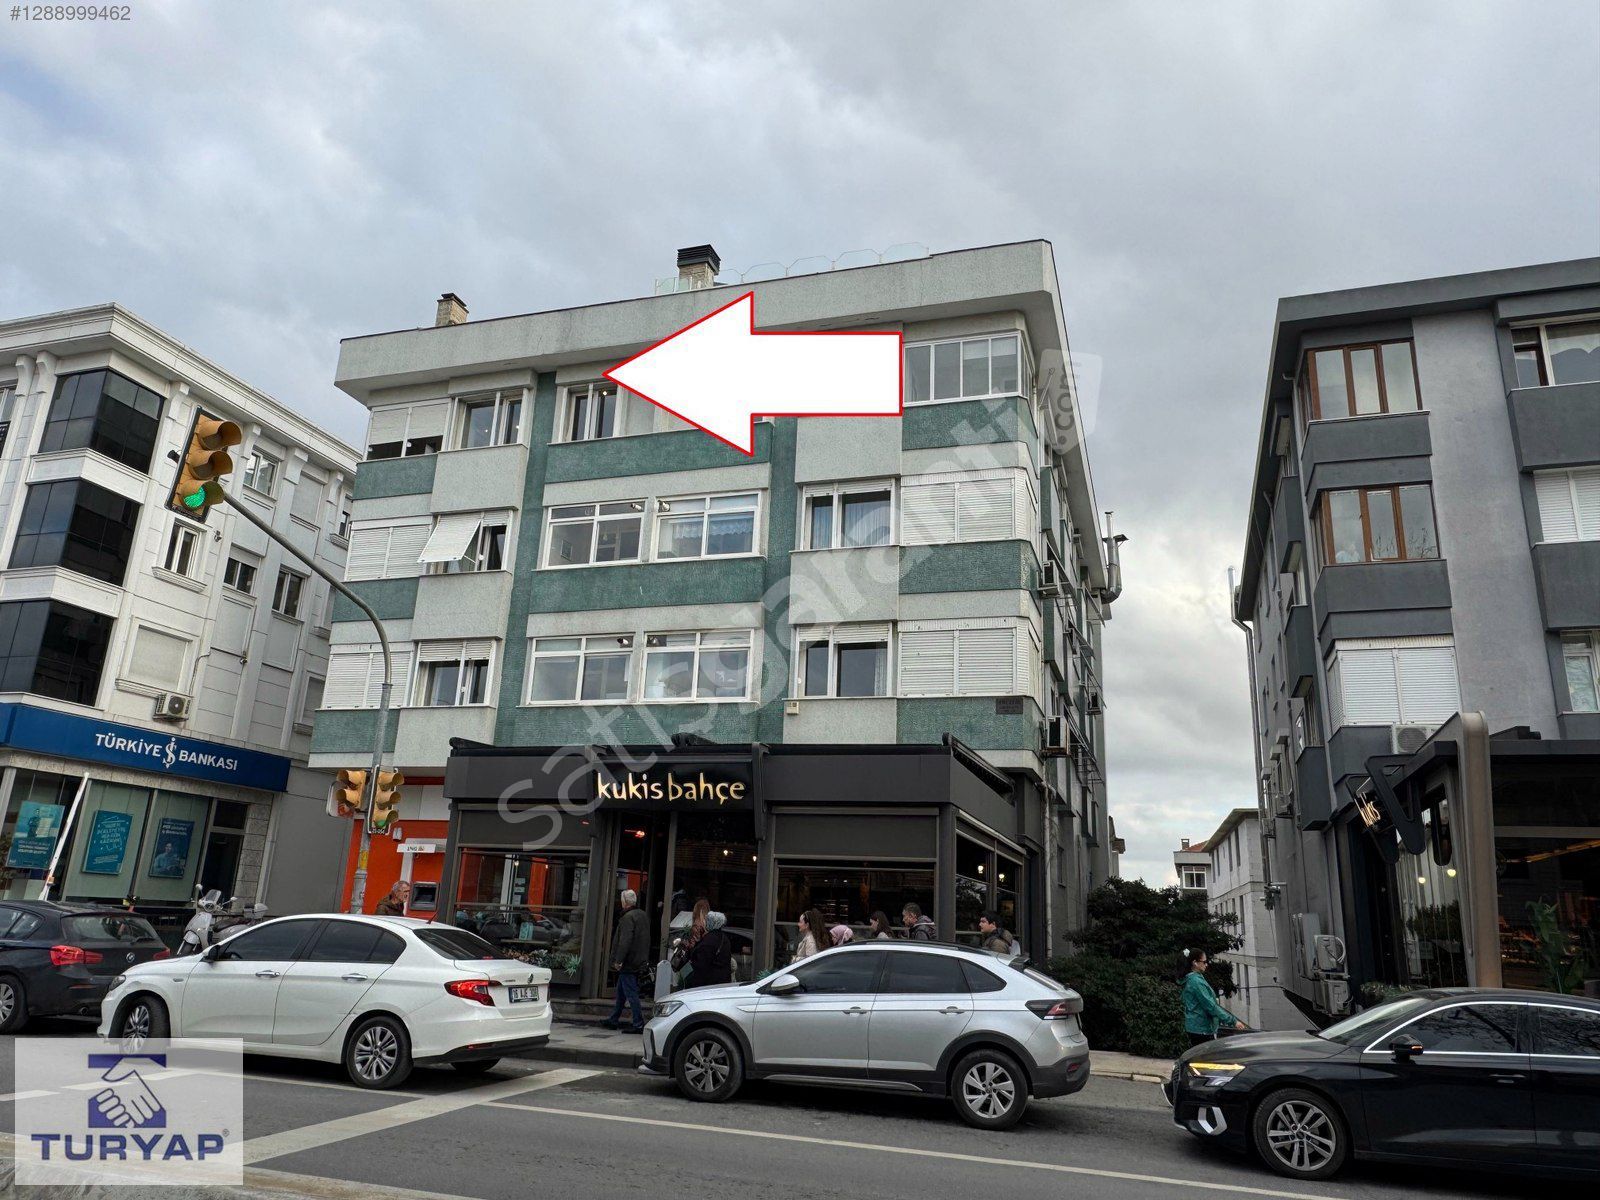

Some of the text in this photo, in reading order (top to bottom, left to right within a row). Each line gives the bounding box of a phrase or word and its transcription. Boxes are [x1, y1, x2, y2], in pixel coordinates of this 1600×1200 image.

[95, 732, 162, 757] TÜRKİYE
[178, 750, 238, 771] BANKASI
[597, 772, 746, 805] kukis bahçe
